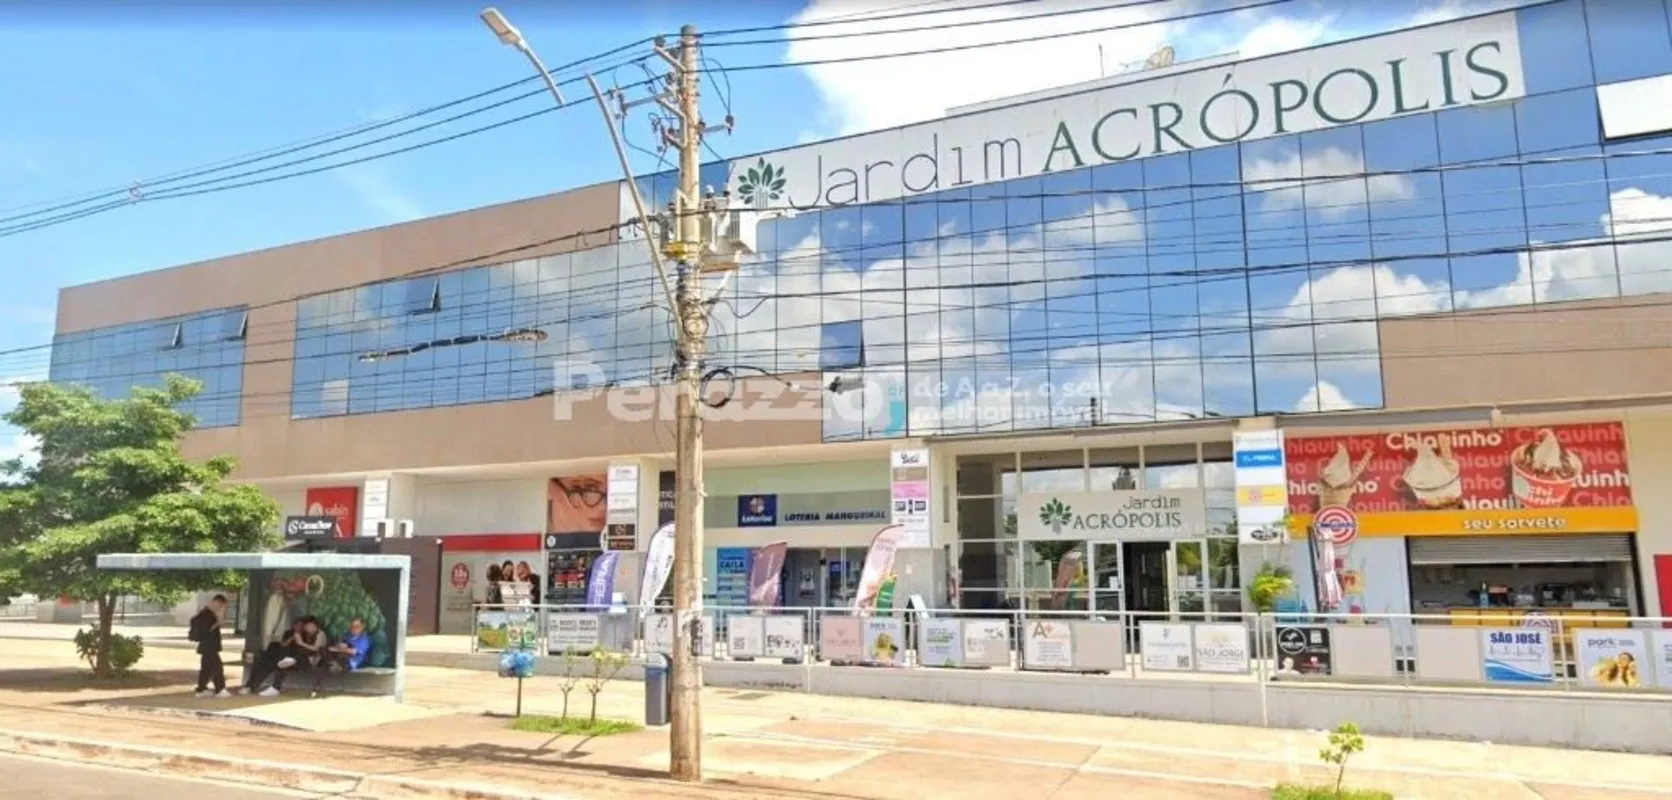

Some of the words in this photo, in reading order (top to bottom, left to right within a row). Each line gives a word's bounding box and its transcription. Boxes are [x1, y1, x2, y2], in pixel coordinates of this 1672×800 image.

[788, 133, 1022, 211] Jardim
[1043, 40, 1510, 172] ACRÓPOLIS
[1123, 495, 1181, 509] Jardim
[784, 511, 820, 522] LOTERIA
[1072, 509, 1182, 529] ACRÓPOLIS
[1463, 518, 1492, 530] seu
[1498, 515, 1566, 530] sorvete
[1490, 631, 1513, 644] SÃO
[1515, 631, 1541, 644] JOSÉ
